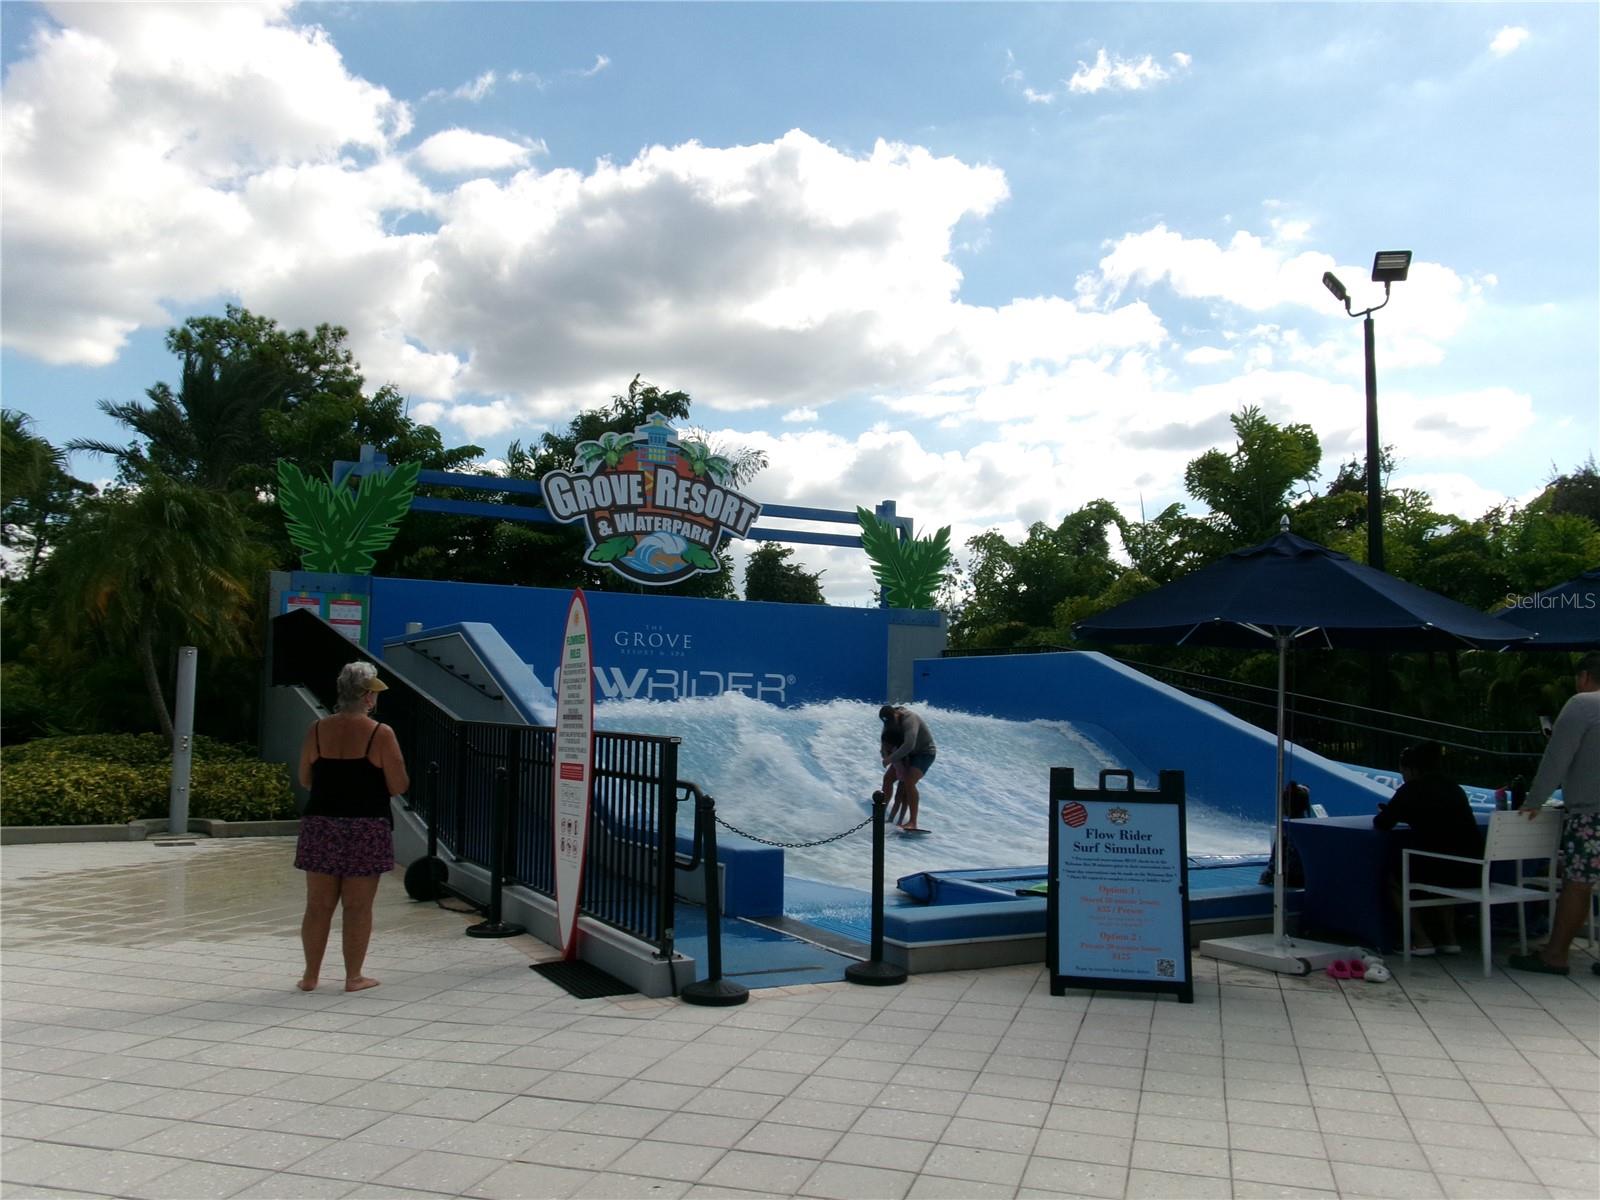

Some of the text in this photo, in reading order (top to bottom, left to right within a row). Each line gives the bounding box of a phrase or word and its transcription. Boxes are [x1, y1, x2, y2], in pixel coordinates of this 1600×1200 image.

[550, 467, 756, 532] GROVE RESORT
[598, 511, 713, 545] & WATERPARK
[614, 631, 693, 649] GROVE
[1086, 828, 1153, 841] Flow Rider
[1073, 842, 1165, 856] Surf Simulator
